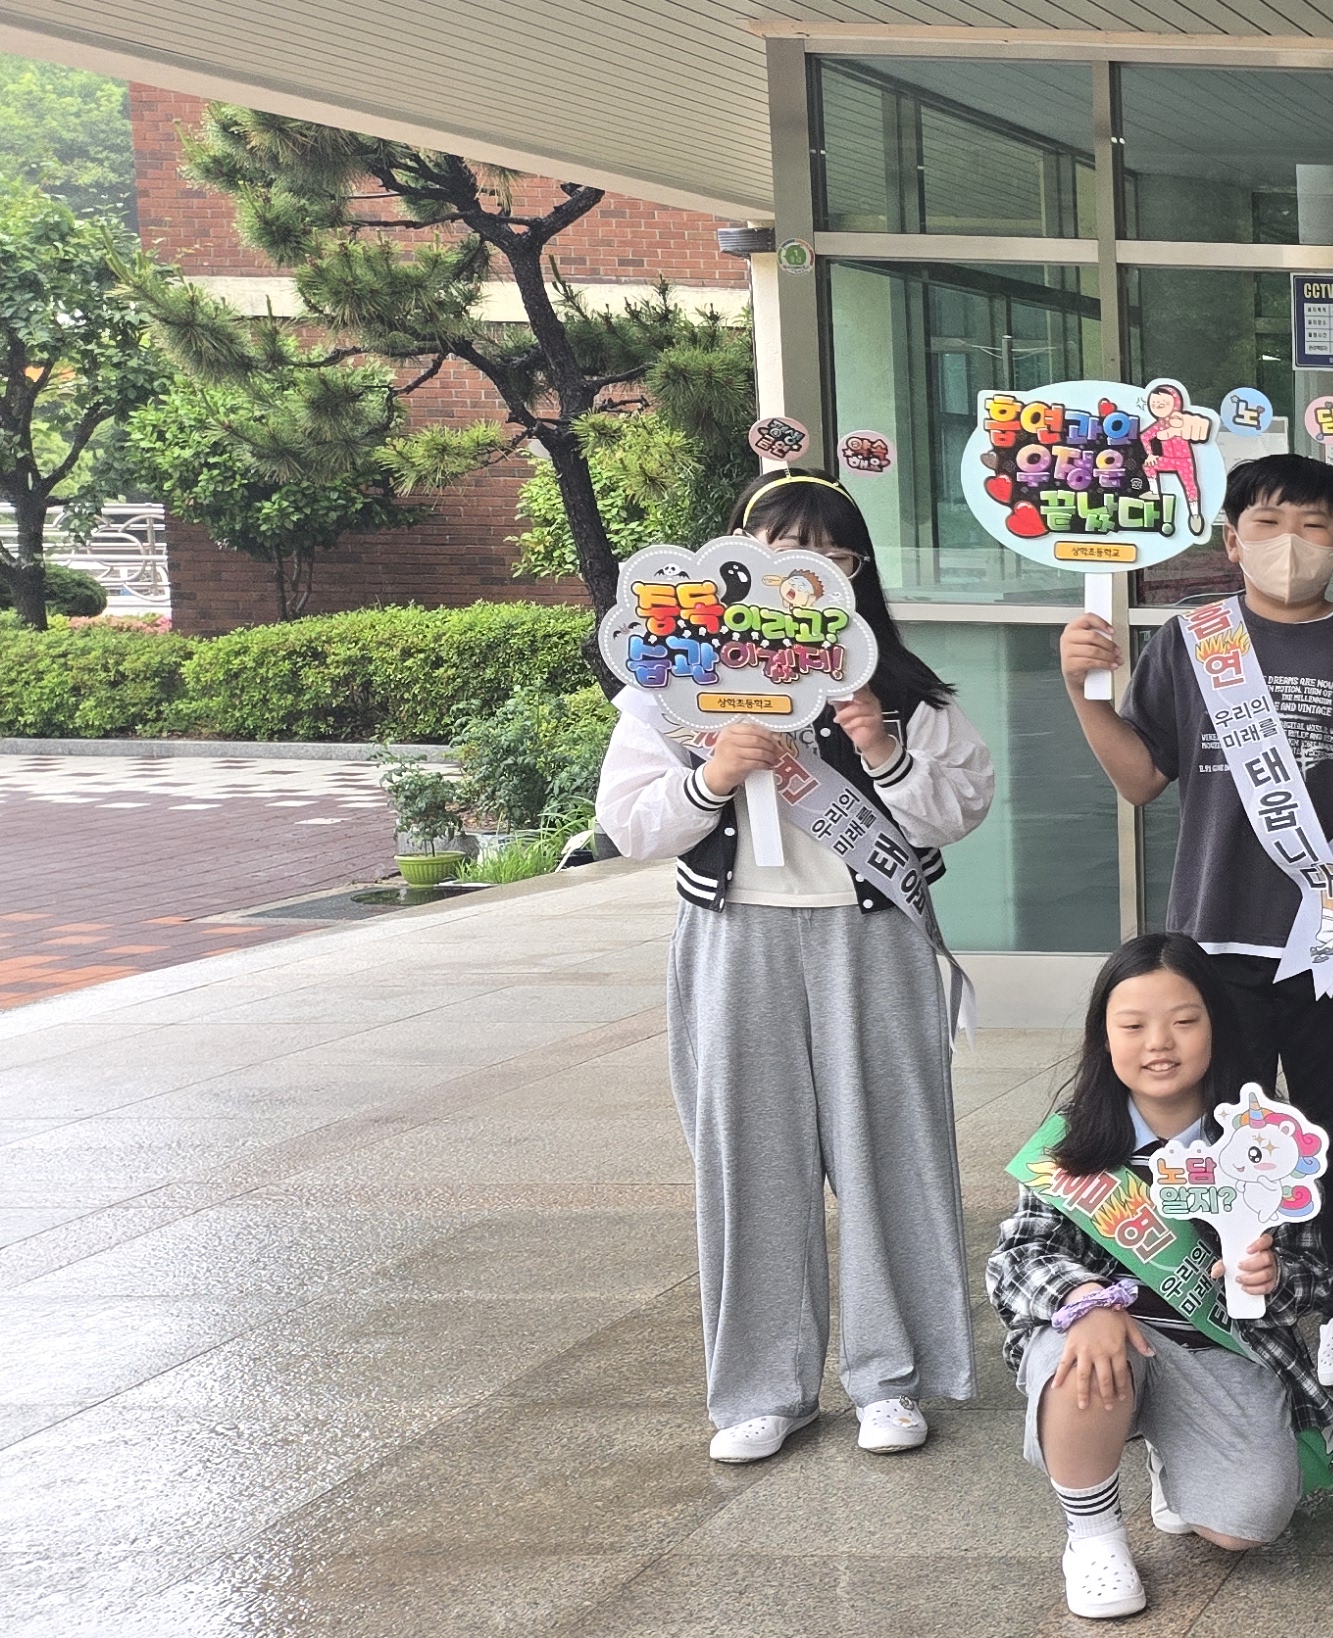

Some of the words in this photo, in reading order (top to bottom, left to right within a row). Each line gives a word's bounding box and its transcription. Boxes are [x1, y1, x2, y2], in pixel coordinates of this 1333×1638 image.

[984, 394, 1141, 449] 흡연과의
[1232, 398, 1262, 427] 노
[1015, 443, 1127, 491] 우정은
[1040, 489, 1177, 538] 끝났다!
[630, 580, 850, 644] 중독이라고?
[626, 634, 847, 689] 습관이겠지!
[1268, 675, 1299, 686] DREAMS
[717, 697, 773, 709] 상학초등학교
[1214, 695, 1271, 728] 우리의
[1280, 702, 1297, 712] AND
[1297, 704, 1333, 717] VINTAGE
[1222, 717, 1279, 749] 미래를
[811, 787, 861, 842] 우리의
[832, 805, 877, 857] 미래를
[1156, 1157, 1218, 1186] 노담
[1159, 1186, 1238, 1215] 알지?
[1159, 1238, 1213, 1299] 우리의
